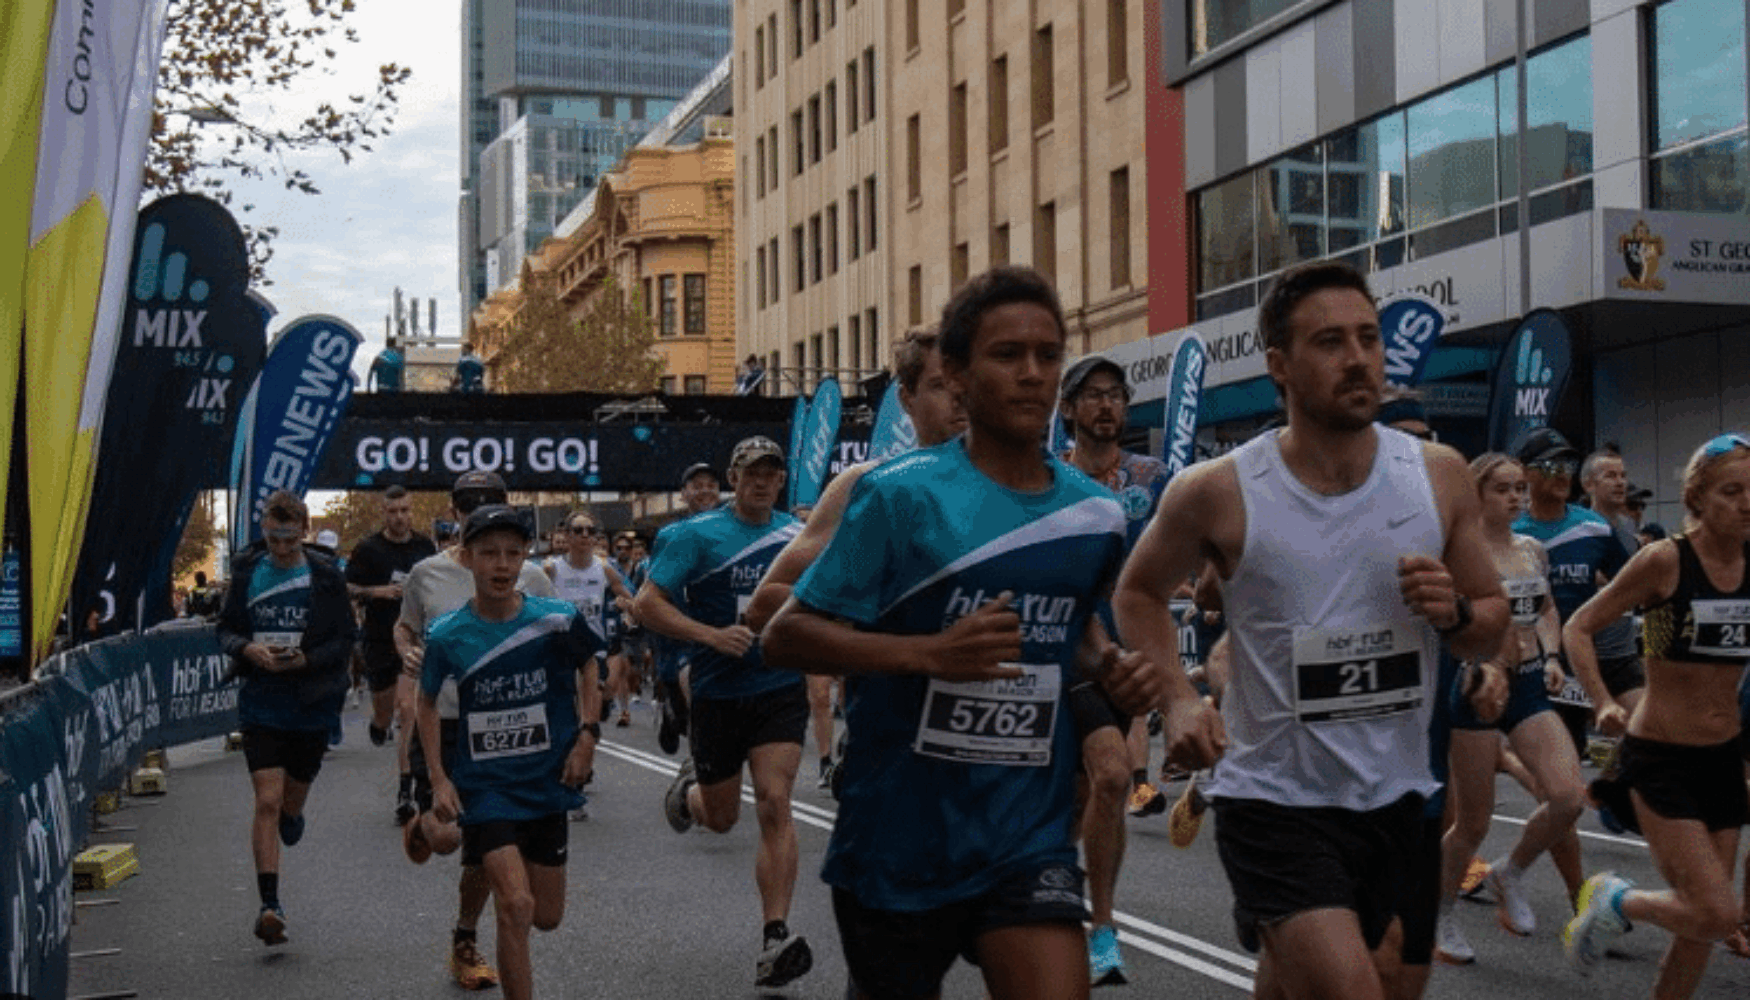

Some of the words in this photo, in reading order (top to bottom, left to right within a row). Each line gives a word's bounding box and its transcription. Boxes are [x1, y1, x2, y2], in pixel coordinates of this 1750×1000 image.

[65, 0, 94, 114] Com
[1690, 240, 1711, 257] ST
[133, 309, 208, 347] MIX
[1206, 331, 1264, 362] NGLICA
[1515, 387, 1548, 416] MIX
[355, 436, 430, 472] GO!
[441, 436, 515, 473] GO!
[526, 436, 600, 473] GO!
[839, 441, 869, 461] ru
[1338, 659, 1379, 694] 21
[949, 699, 1039, 736] 5762
[482, 727, 534, 751] 6277
